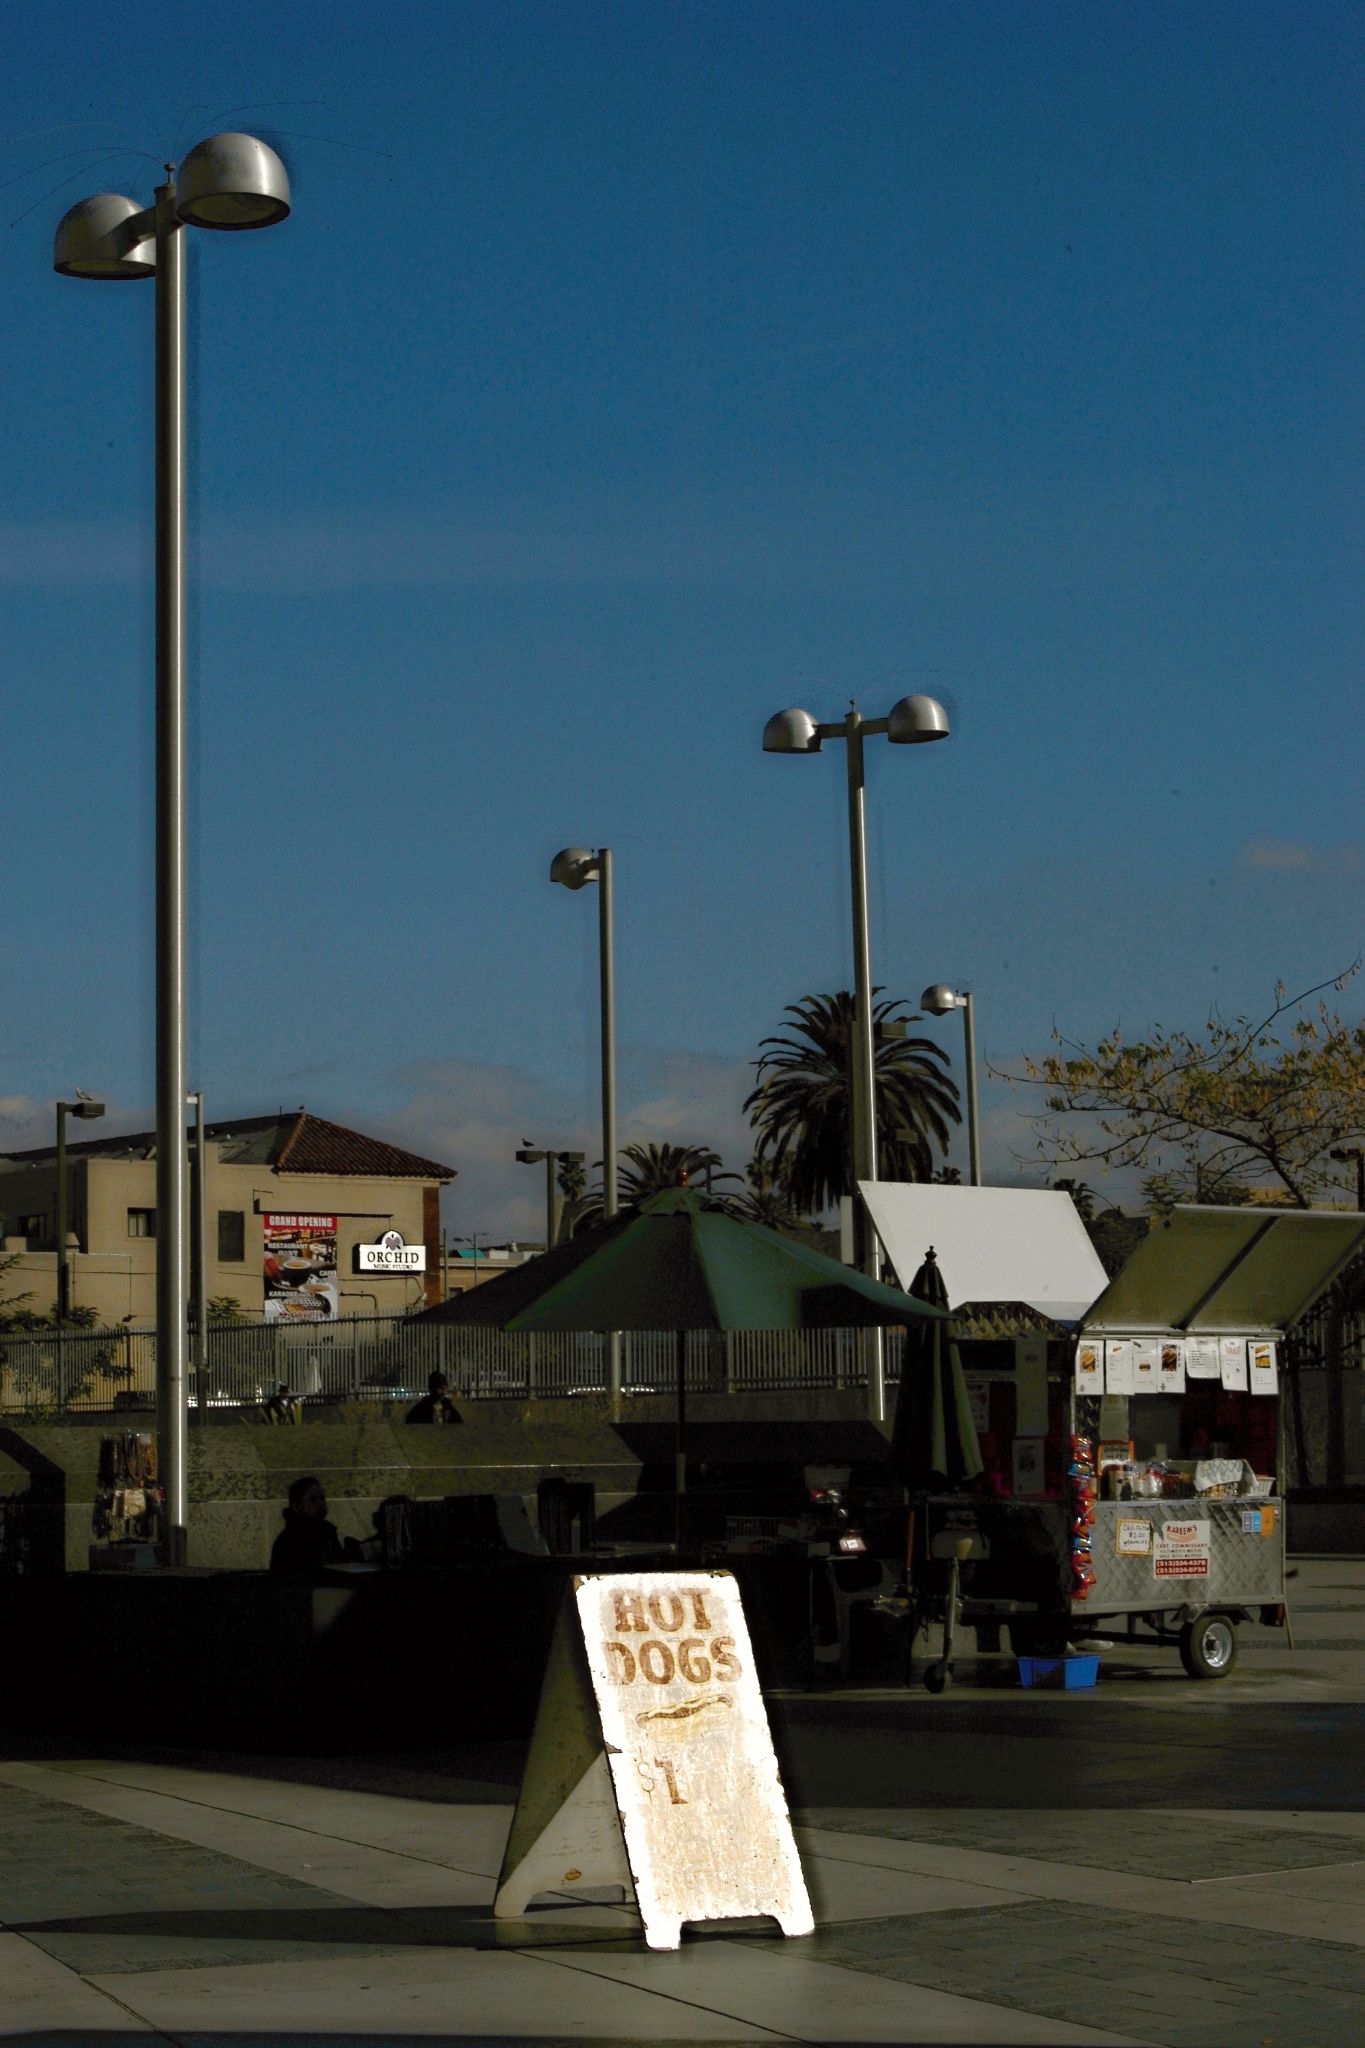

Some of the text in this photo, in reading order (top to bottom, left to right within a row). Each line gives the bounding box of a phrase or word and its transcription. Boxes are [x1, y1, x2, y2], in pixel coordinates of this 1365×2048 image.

[269, 1216, 333, 1227] GRAND OPENING
[367, 1251, 419, 1263] ORCHID
[609, 1588, 711, 1632] HOT
[604, 1636, 742, 1685] DOGS
